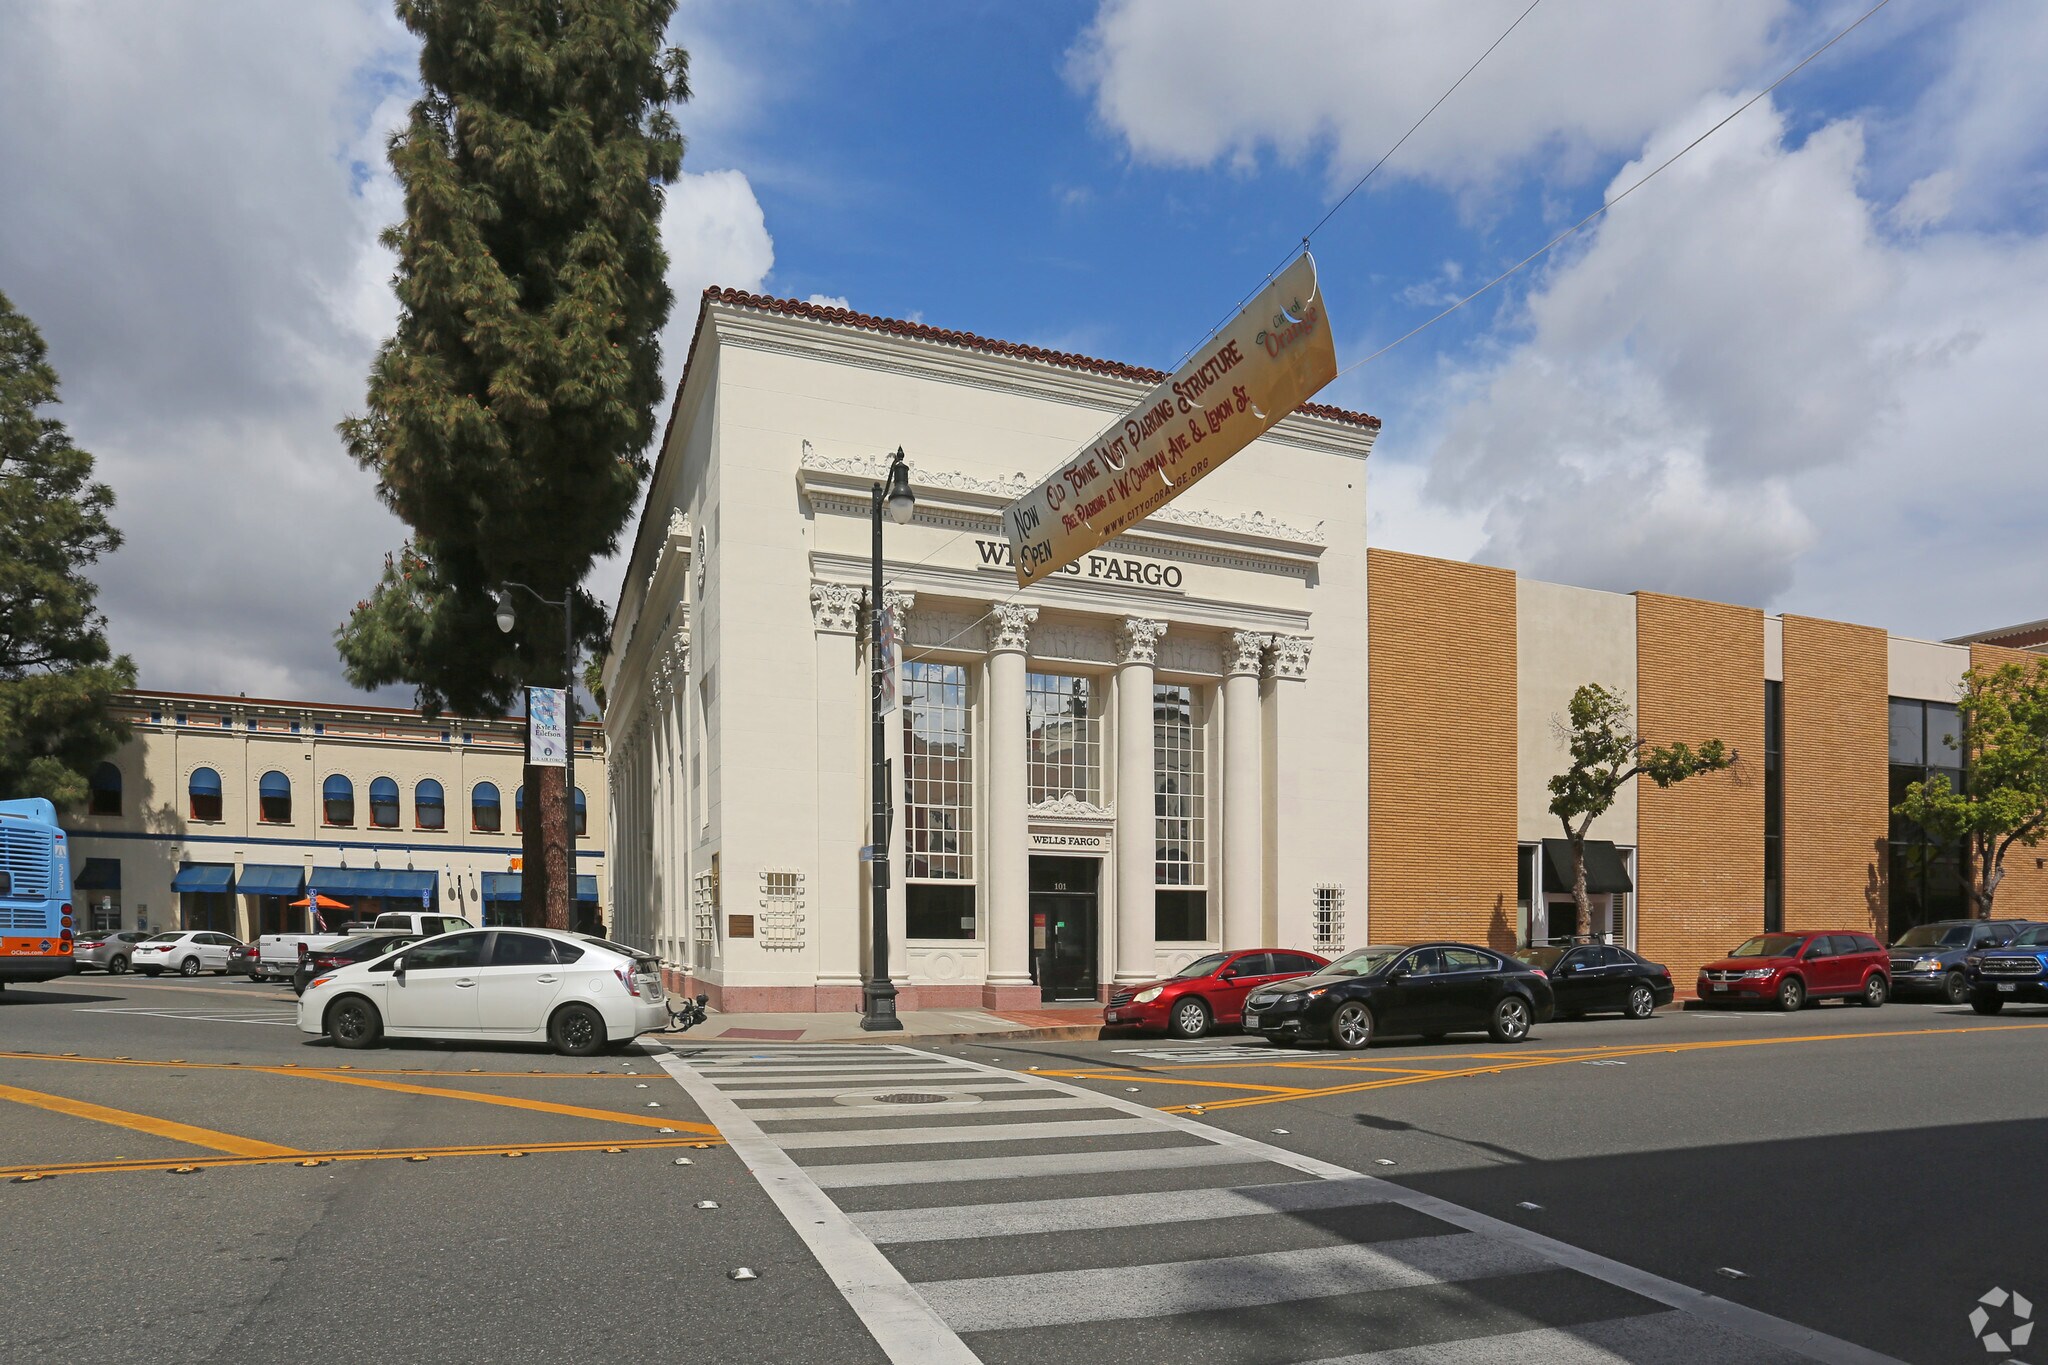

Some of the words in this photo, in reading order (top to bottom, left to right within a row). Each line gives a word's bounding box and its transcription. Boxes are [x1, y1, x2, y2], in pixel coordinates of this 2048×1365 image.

[1291, 297, 1300, 313] of
[1046, 483, 1066, 511] OLD
[1063, 459, 1099, 497] TOWNE
[1125, 399, 1174, 452] PARKING
[1172, 339, 1244, 414] STRUCTURE
[1075, 494, 1107, 523] PARKING
[1107, 486, 1116, 504] AT
[1130, 450, 1168, 492] CHAPMAN
[1168, 433, 1191, 465] AVE
[1188, 418, 1207, 443] &
[1204, 398, 1234, 434] LEMON
[1013, 505, 1040, 543] NOW
[1021, 539, 1052, 577] OPEN
[1088, 555, 1183, 588] FARGO
[1032, 836, 1066, 845] WELLS
[1068, 837, 1100, 846] FARGO
[1054, 882, 1067, 891] 101
